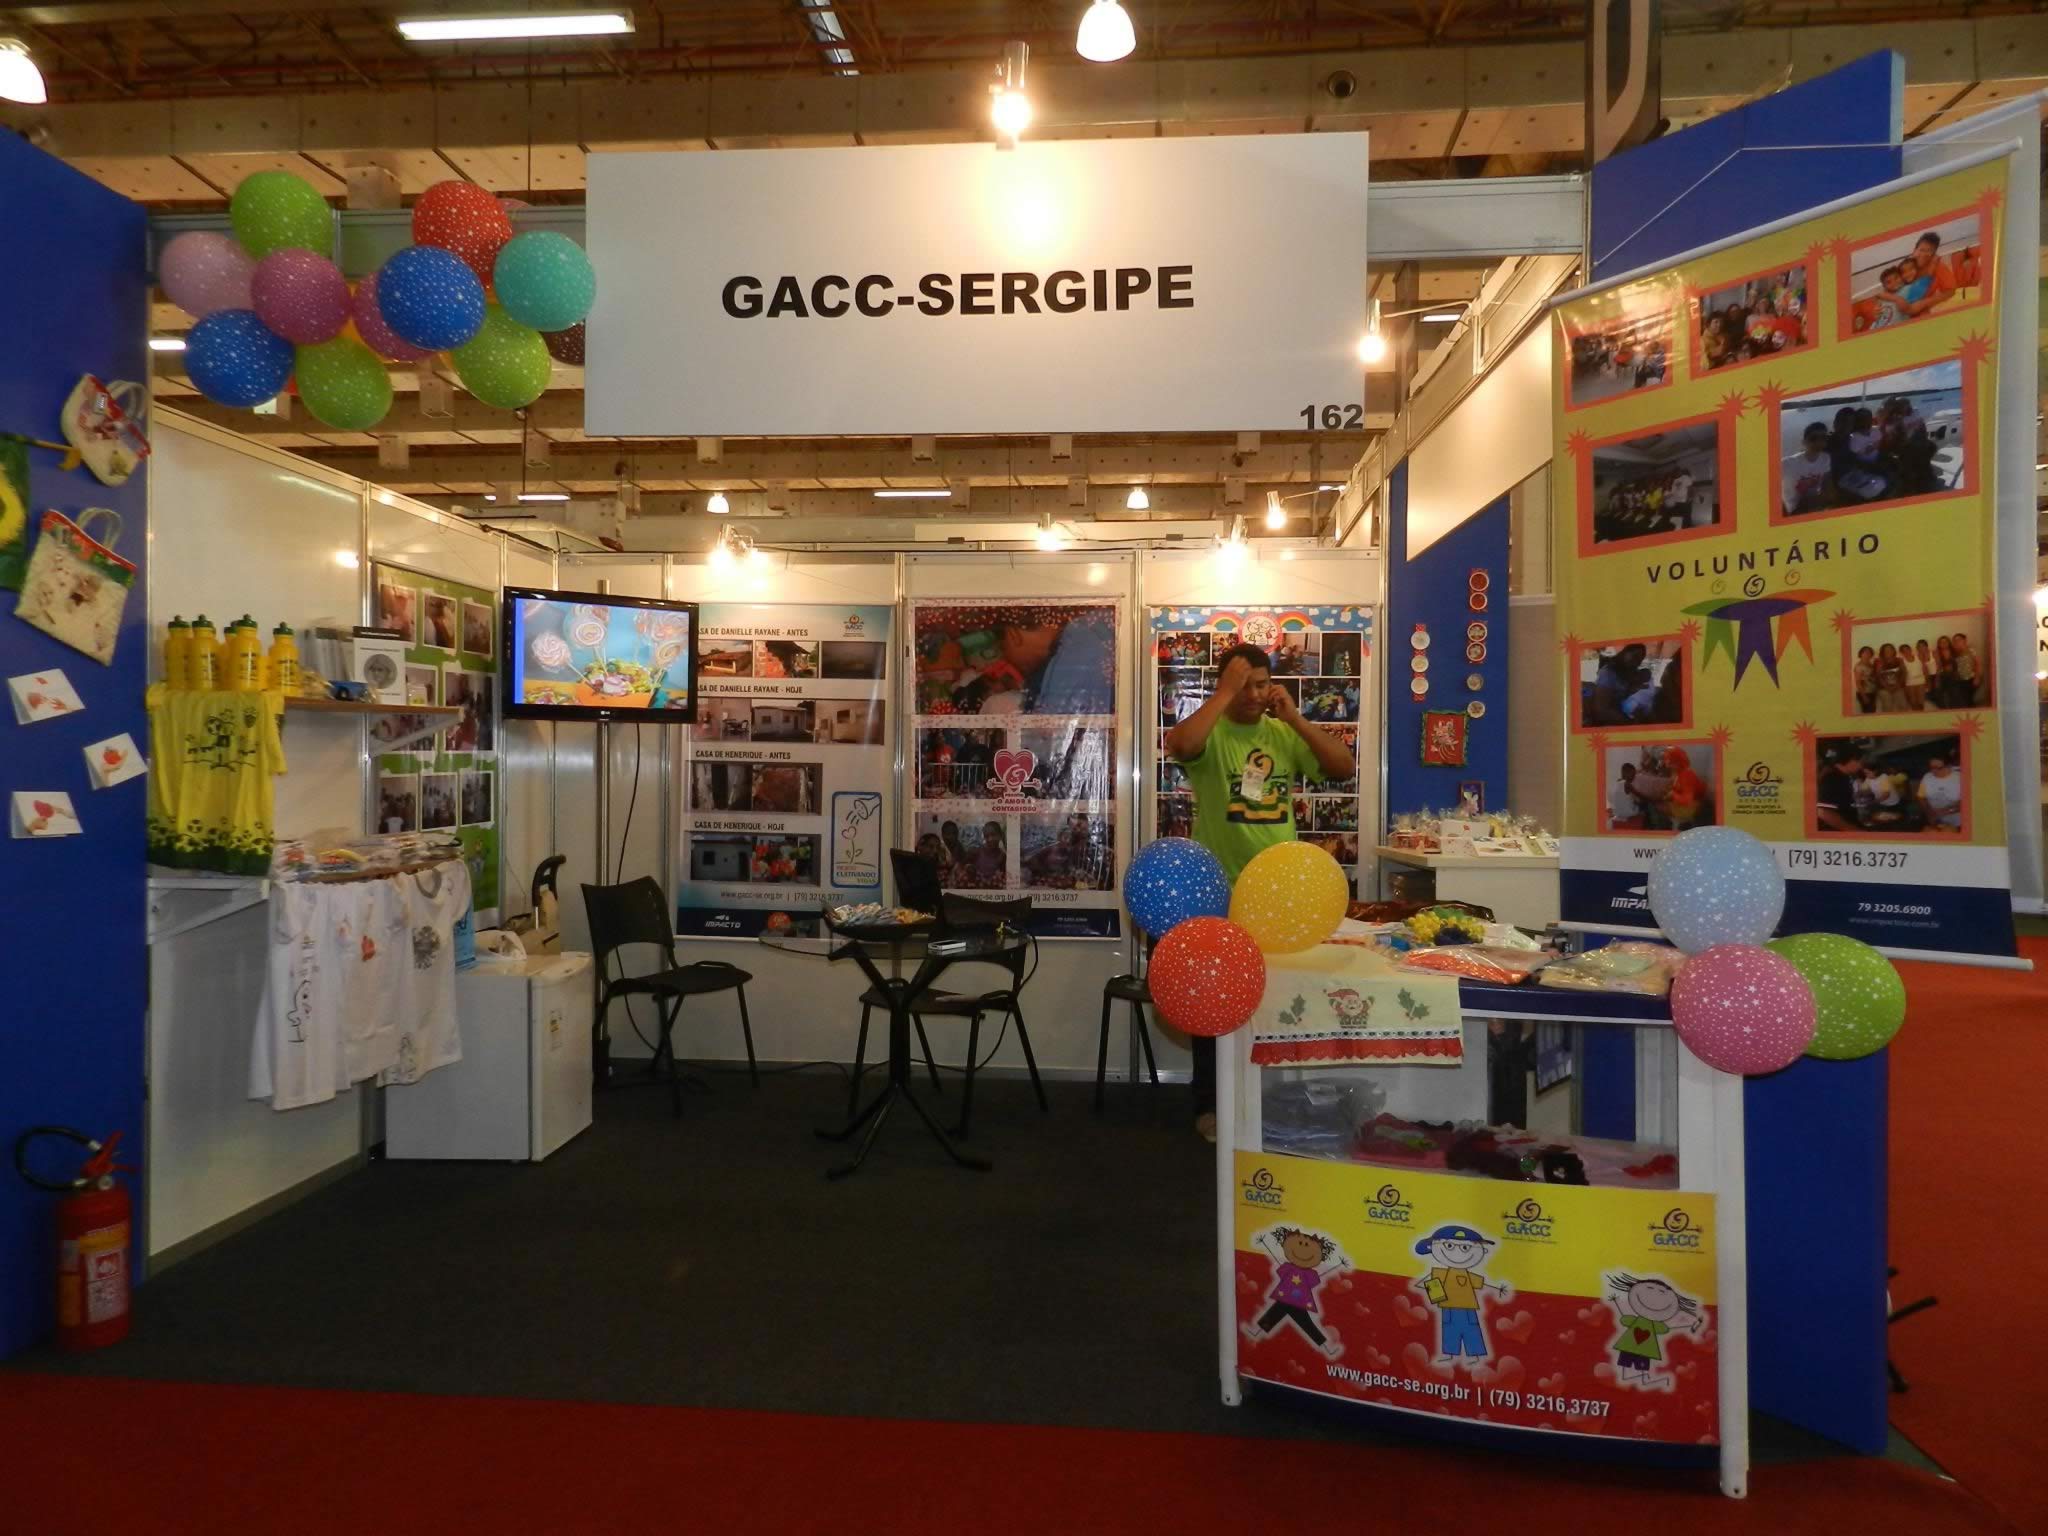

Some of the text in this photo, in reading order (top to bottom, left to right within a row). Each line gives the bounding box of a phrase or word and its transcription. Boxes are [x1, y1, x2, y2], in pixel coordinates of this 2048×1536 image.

[722, 265, 1194, 319] GACC-SERGIPE
[1300, 404, 1364, 430] 162
[1647, 533, 1880, 584] VOLUNTÁRIO
[721, 628, 753, 636] DANIELLE
[754, 628, 781, 636] RAYANE
[720, 685, 752, 693] DANIELLE
[753, 685, 779, 693] RAYANE
[785, 686, 803, 694] HOJE
[695, 750, 713, 758] CASA
[725, 751, 763, 759] HENERIQUE
[769, 752, 791, 760] ANTES
[1737, 785, 1779, 798] GACC
[694, 821, 712, 829] CASA
[723, 822, 761, 830] HENERIQUE
[767, 823, 785, 831] HOJE
[1789, 849, 1817, 868] [79]
[1823, 850, 1908, 868] 3216.3737
[1858, 902, 1932, 915] 79 3205.6900
[705, 920, 742, 929] IMPACTO
[1245, 1189, 1282, 1205] GACC
[1368, 1206, 1410, 1223] GACC
[1506, 1221, 1552, 1237] GACC
[1653, 1232, 1700, 1248] GACC
[1326, 1364, 1470, 1401] www.gacc-se.org.br
[1489, 1388, 1521, 1410] (79)
[1526, 1393, 1611, 1418] 3216.3737
